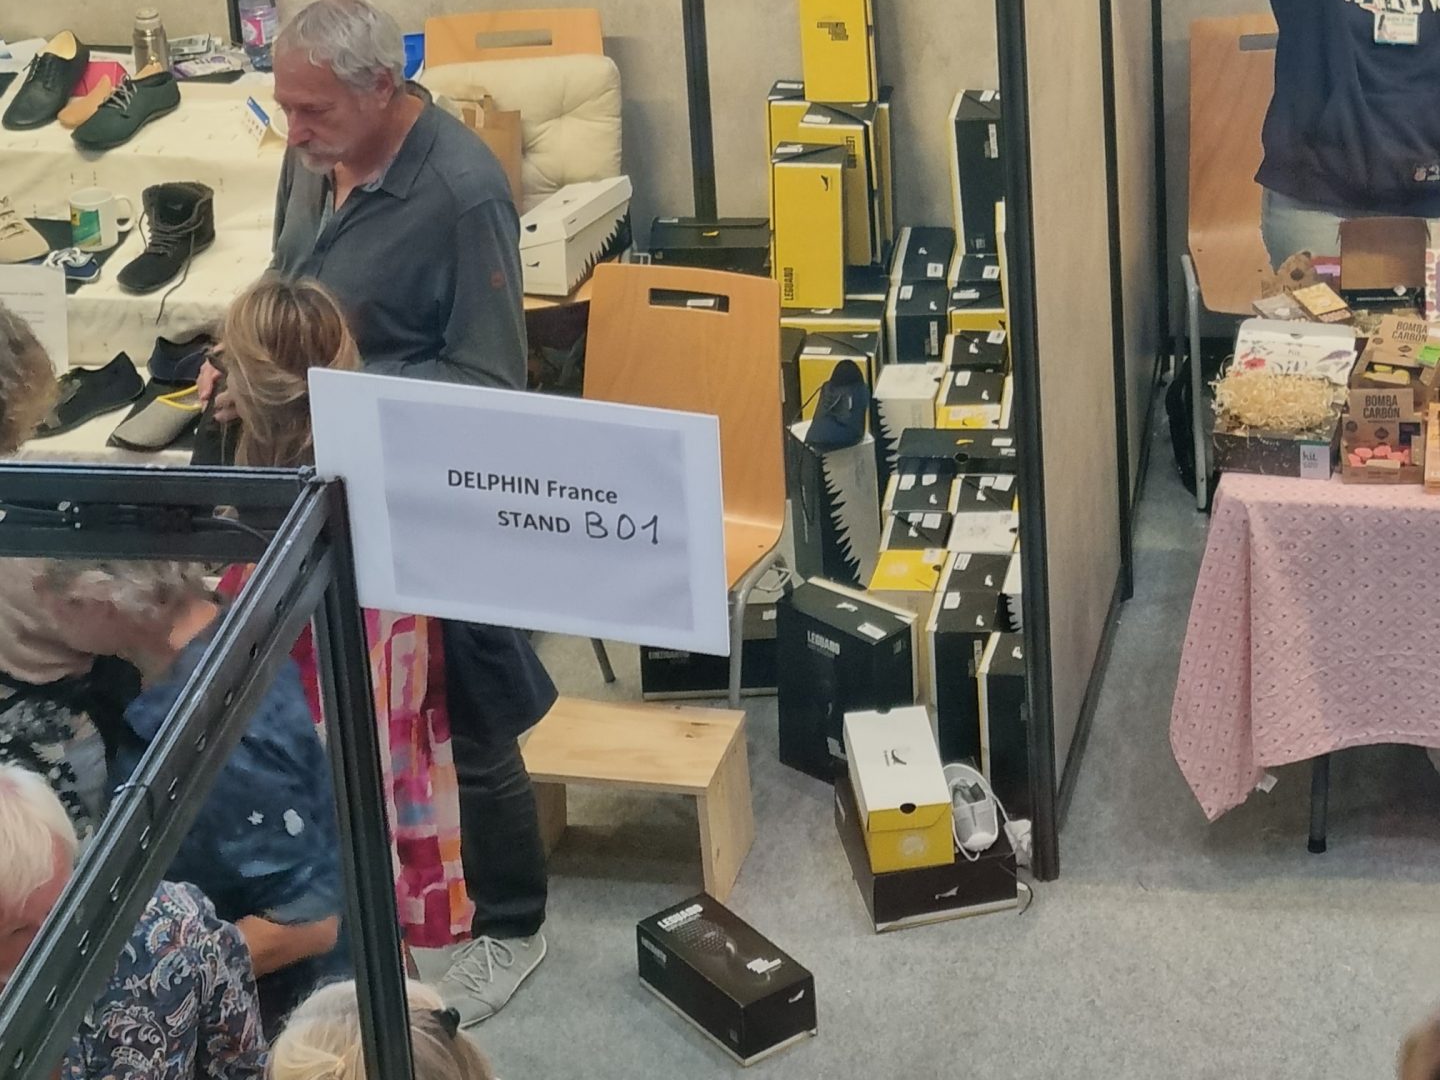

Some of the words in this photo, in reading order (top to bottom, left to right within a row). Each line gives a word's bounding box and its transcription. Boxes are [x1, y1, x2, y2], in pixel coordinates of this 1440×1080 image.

[1395, 320, 1429, 334] BOMBA
[1365, 394, 1398, 407] BOMBA
[447, 468, 540, 496] DELPHIN
[546, 479, 618, 505] France
[497, 509, 571, 534] STAND
